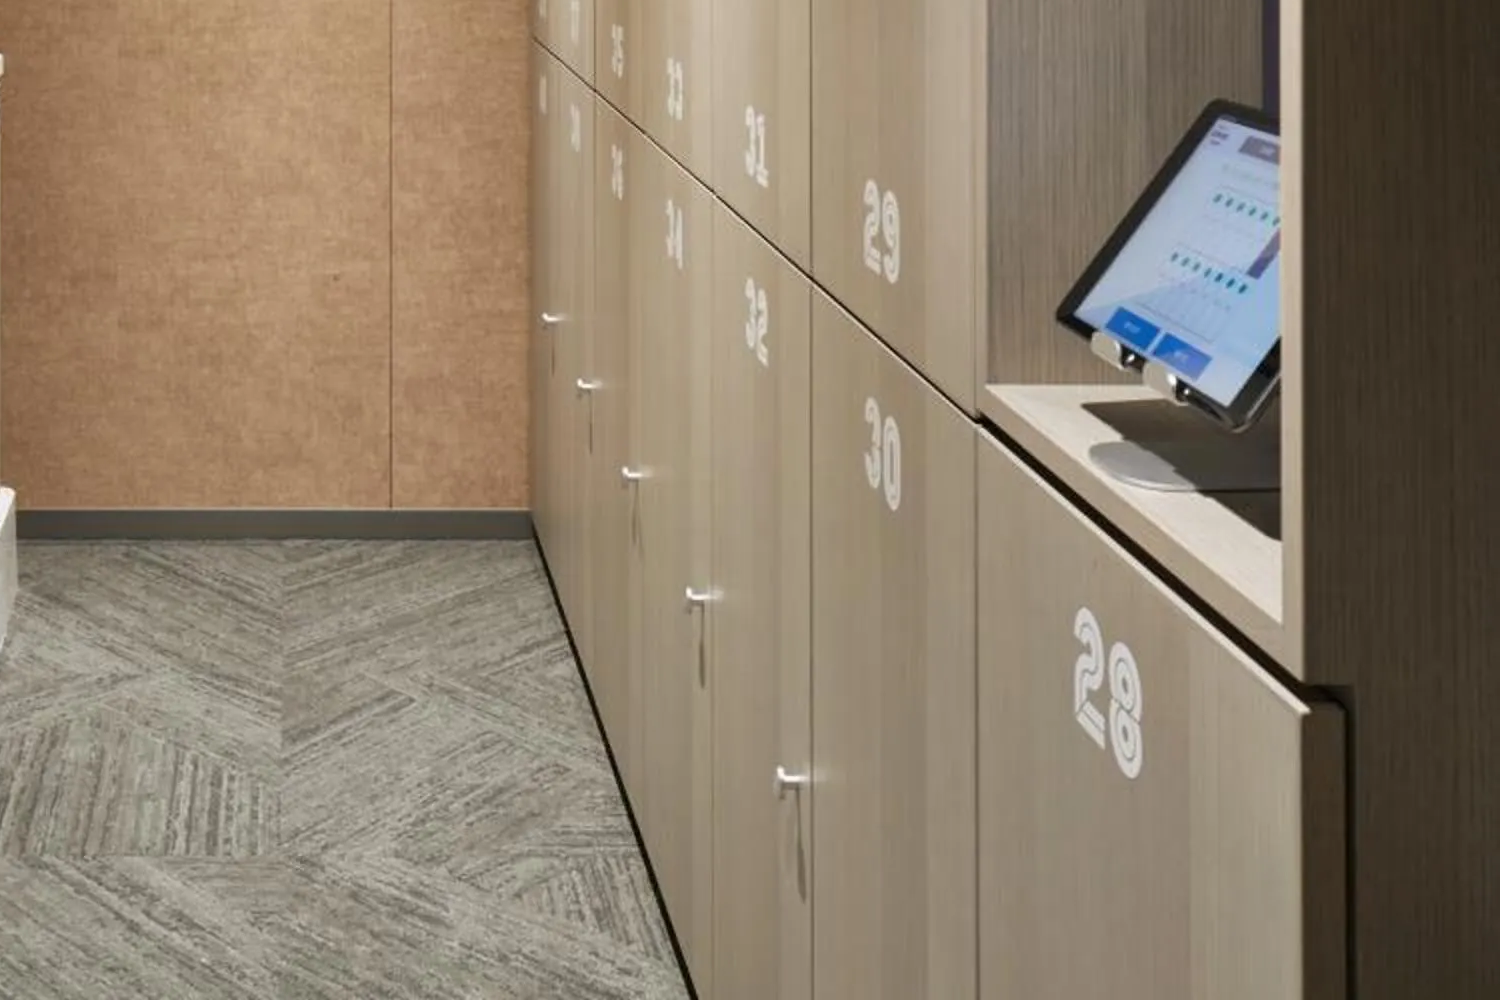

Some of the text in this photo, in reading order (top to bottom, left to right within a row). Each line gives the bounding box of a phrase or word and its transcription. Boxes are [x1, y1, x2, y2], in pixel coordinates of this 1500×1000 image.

[745, 104, 769, 189] 31
[863, 178, 900, 284] 29
[745, 276, 769, 367] 32
[864, 396, 901, 511] 30
[1074, 606, 1143, 779] 28
